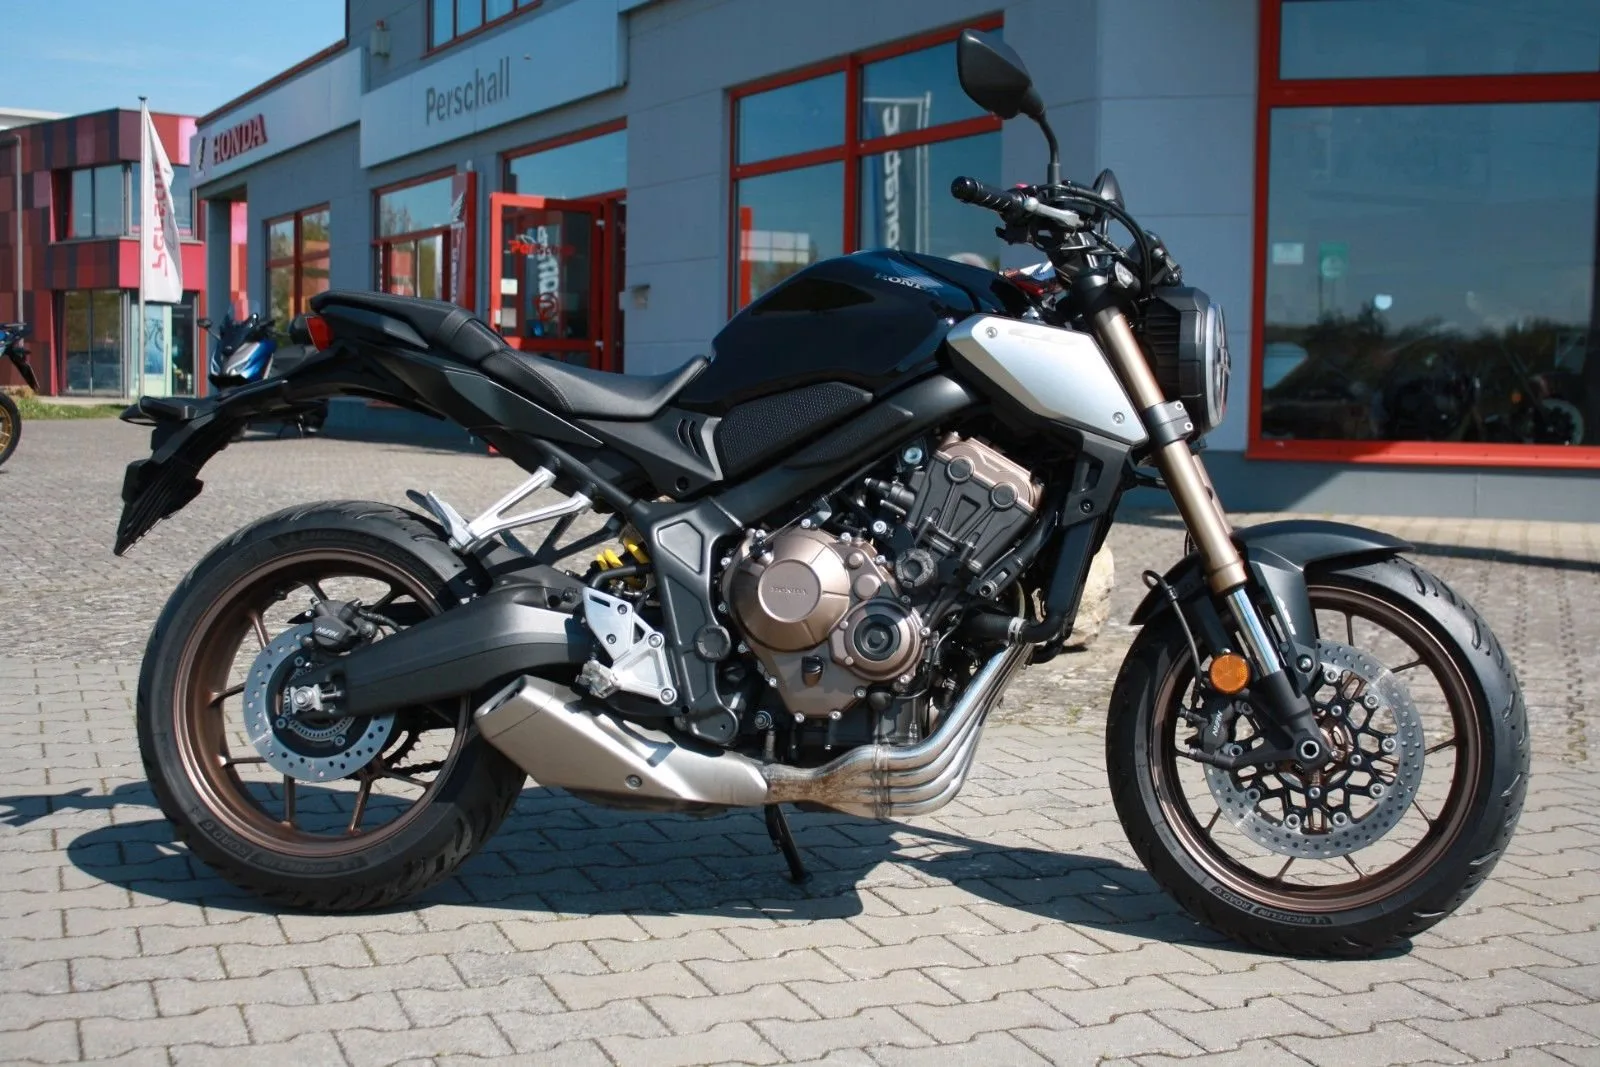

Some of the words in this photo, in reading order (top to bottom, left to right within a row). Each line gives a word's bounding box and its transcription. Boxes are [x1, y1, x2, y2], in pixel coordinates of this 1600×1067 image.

[426, 56, 511, 126] Perschall
[211, 113, 268, 165] HONDA
[1222, 891, 1251, 909] ROAD
[1258, 908, 1311, 924] MICHELIN
